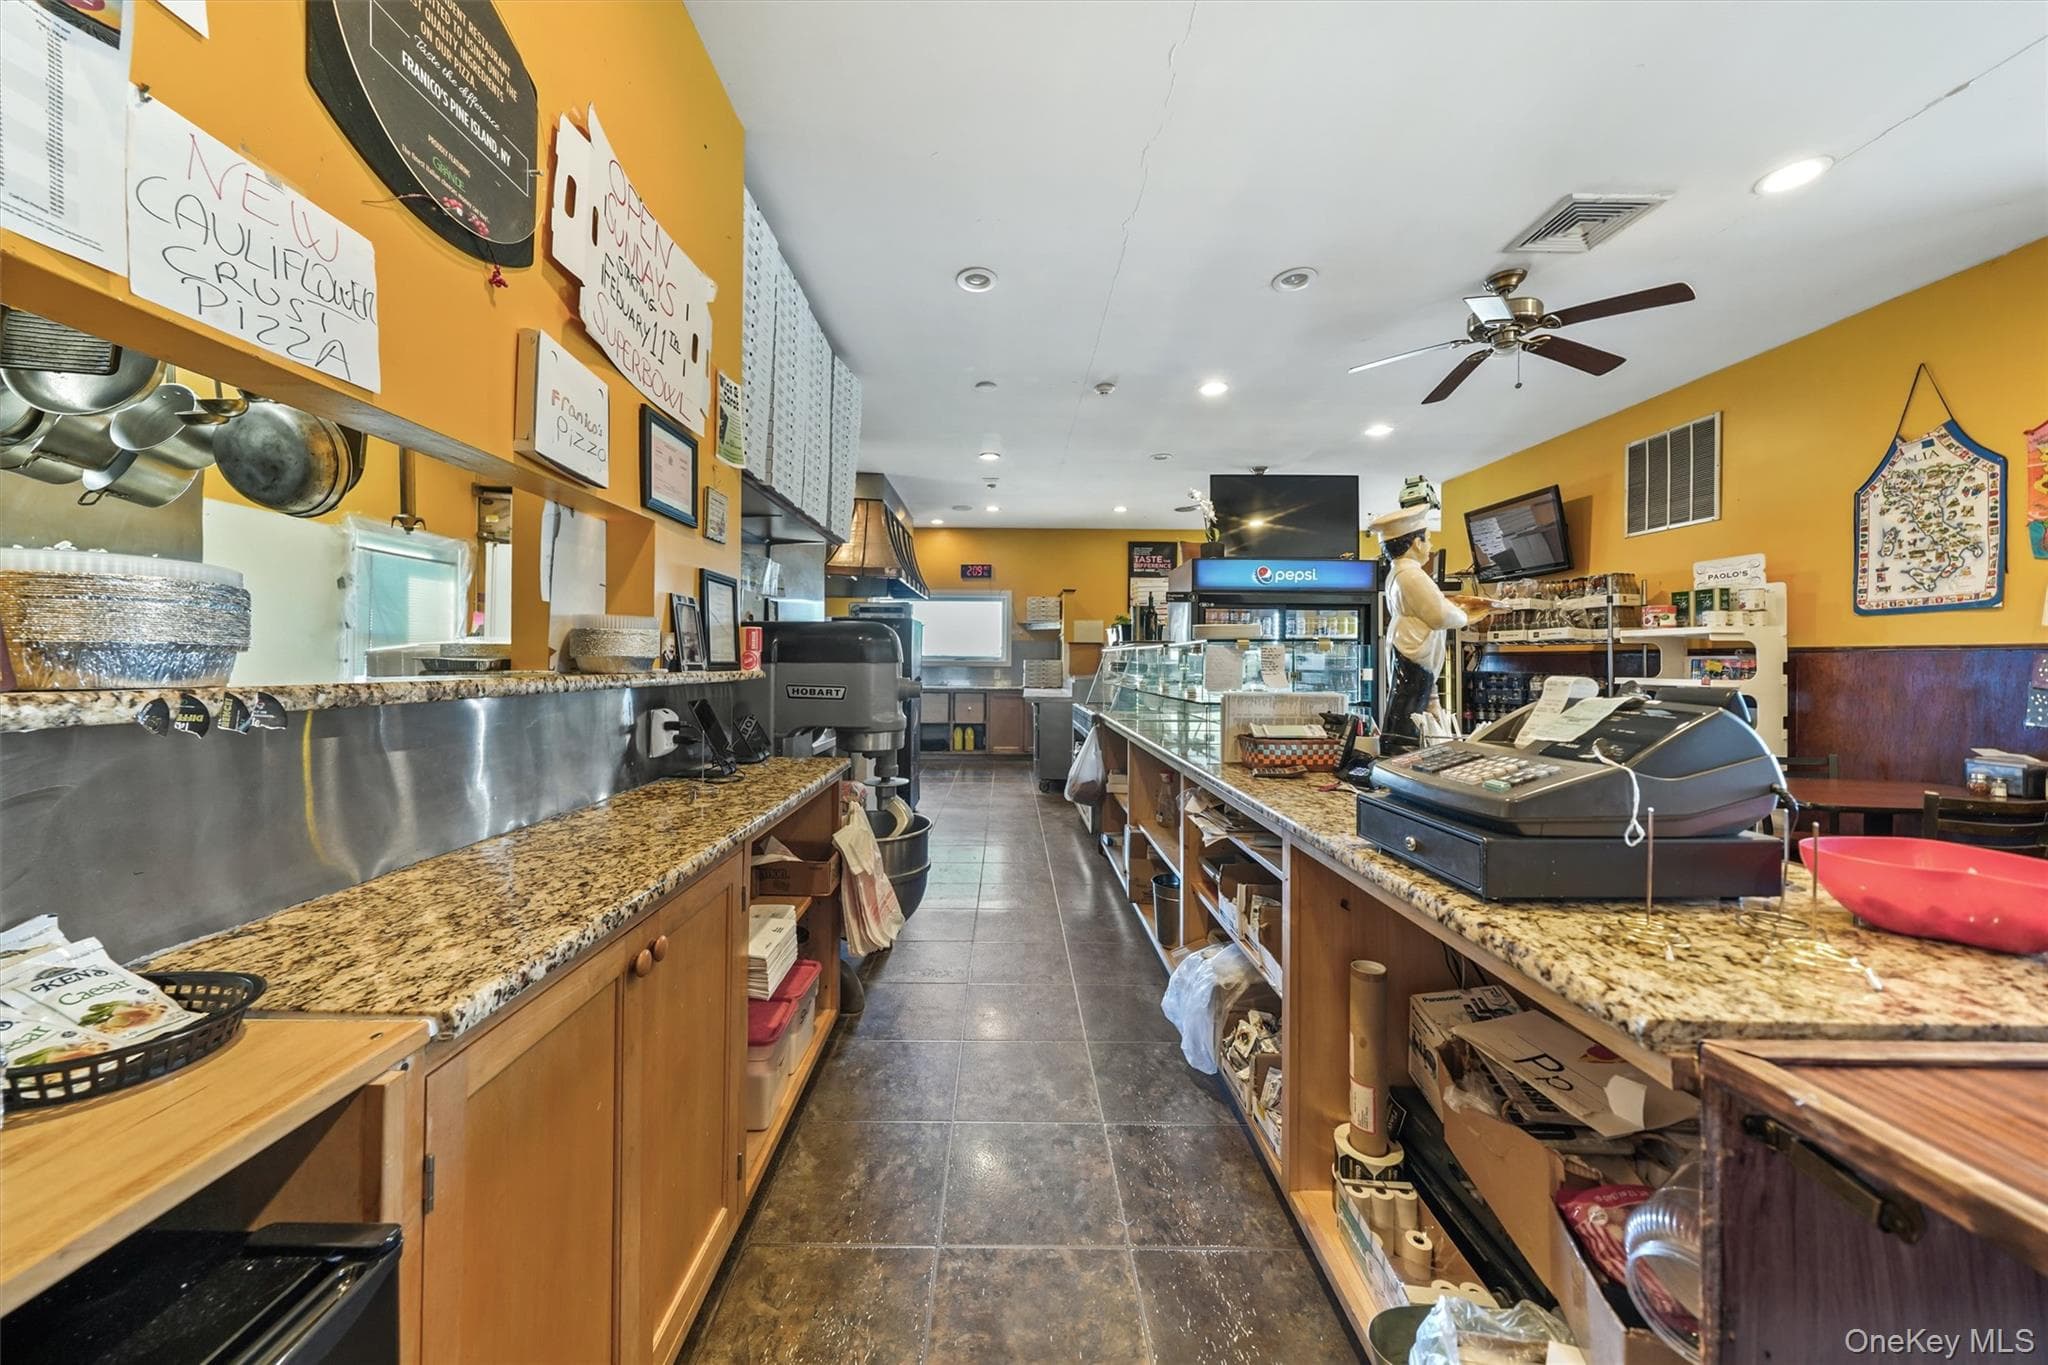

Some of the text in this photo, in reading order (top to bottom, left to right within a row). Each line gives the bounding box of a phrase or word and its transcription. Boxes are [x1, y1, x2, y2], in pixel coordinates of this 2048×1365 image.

[413, 34, 441, 69] Taste
[442, 67, 458, 87] the
[420, 21, 433, 42] ON
[435, 37, 453, 63] OUR
[424, 7, 458, 51] QUALITY
[460, 45, 504, 103] INGREDIENTS
[453, 19, 463, 39] TO
[465, 33, 486, 66] USING
[487, 60, 504, 86] ONLY
[505, 80, 518, 103] THE
[468, 21, 511, 78] RESTAURANT
[401, 49, 449, 107] FRANICO'S
[450, 98, 470, 128] PINE
[500, 147, 512, 167] NY
[188, 133, 340, 262] NEW
[608, 159, 674, 269] OPEN
[605, 192, 677, 317] SUNDAYS
[616, 255, 657, 312] STARTING
[592, 291, 691, 423] SUPERBOWL
[1133, 555, 1163, 563] TASTE
[1275, 567, 1319, 583] pepsi
[1707, 569, 1749, 581] PAOLO'S
[791, 687, 841, 697] HOBART
[58, 979, 132, 1006] Caesar
